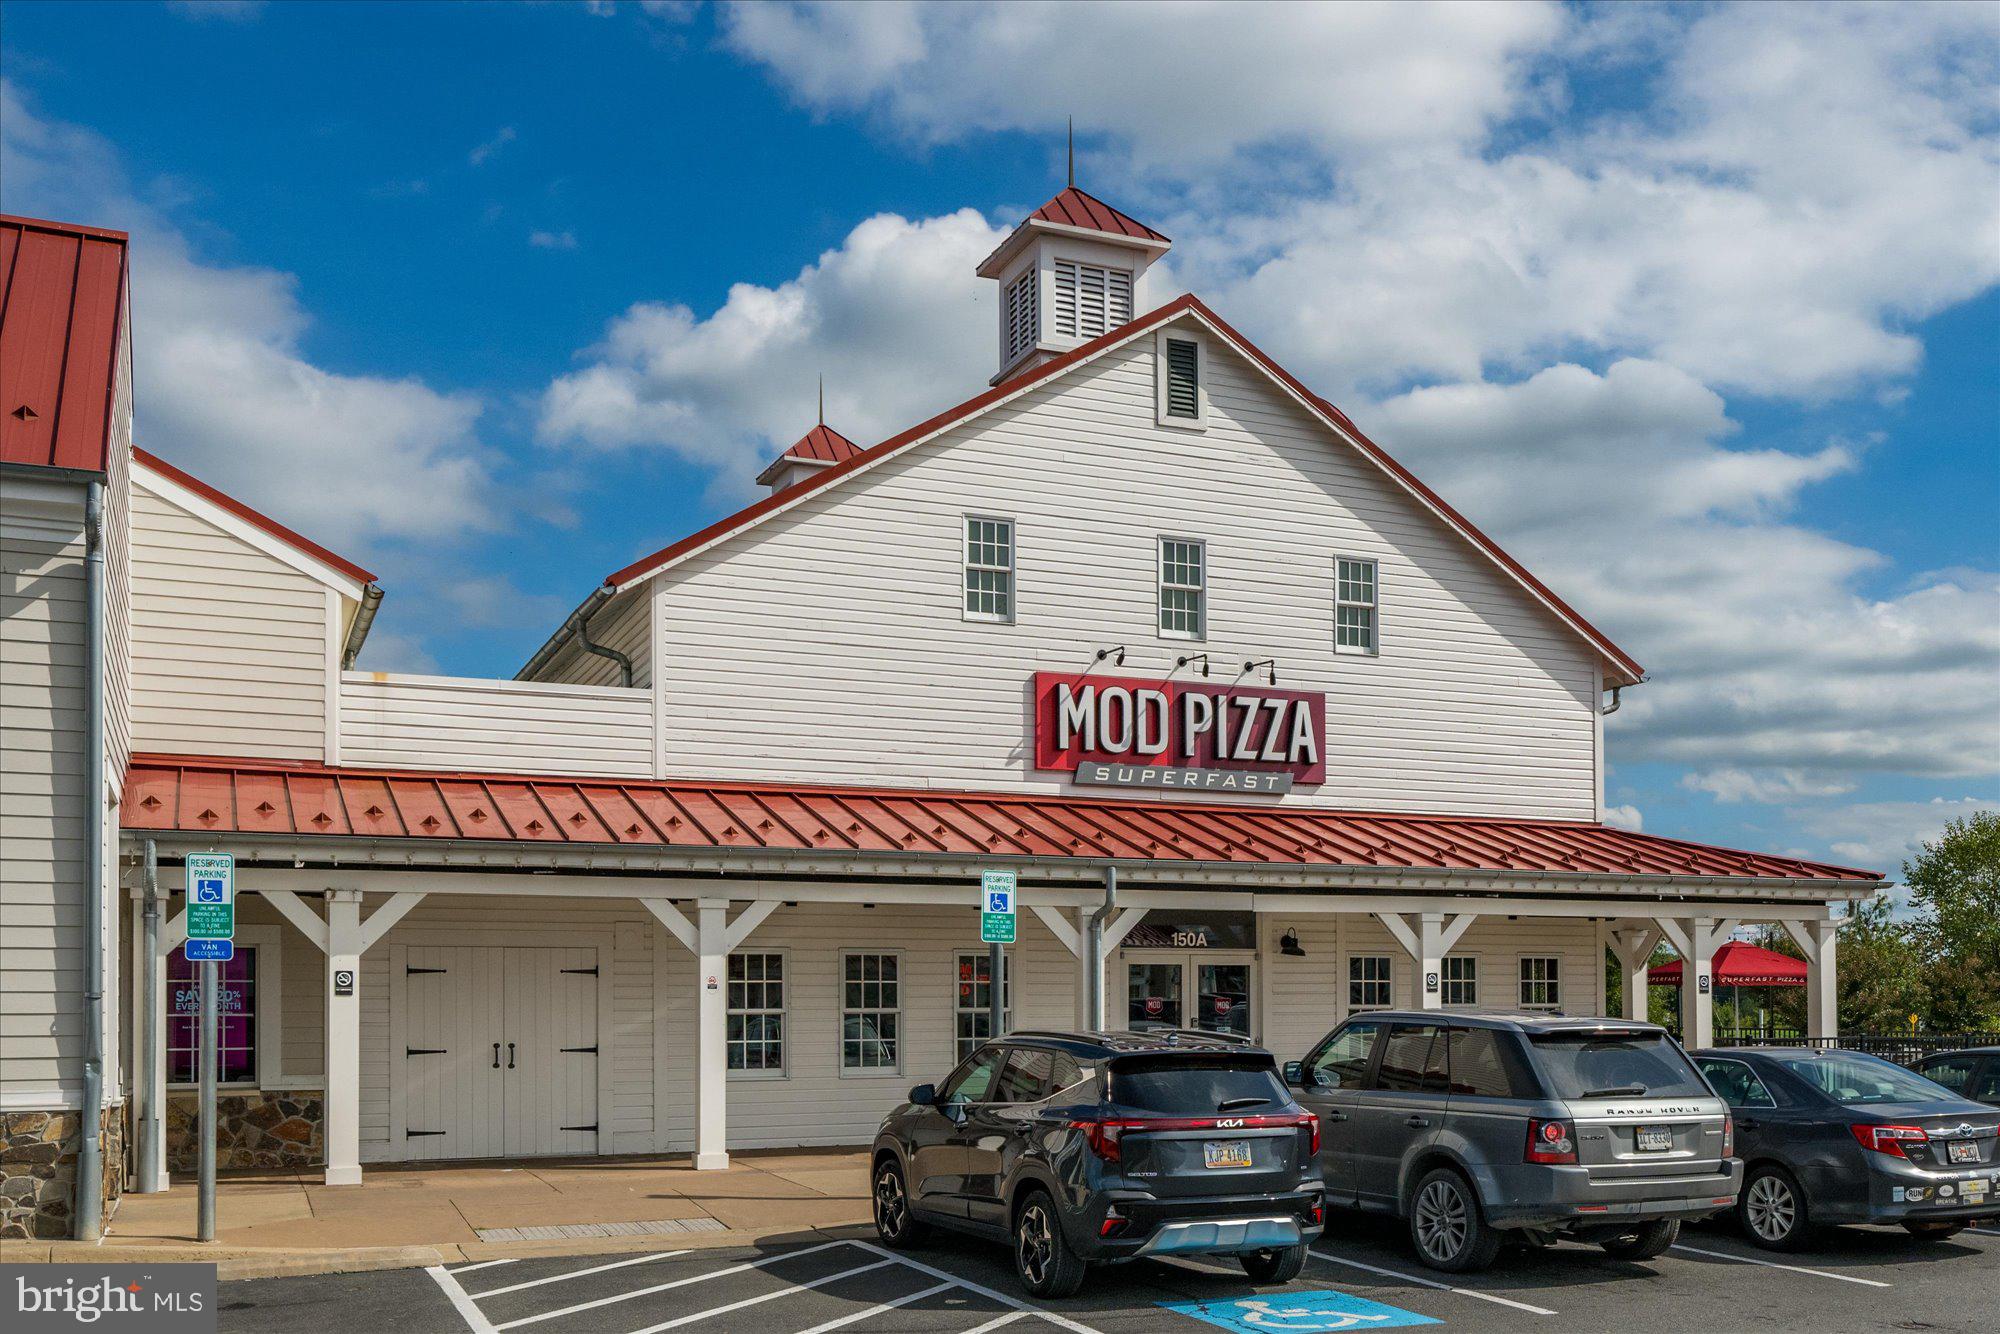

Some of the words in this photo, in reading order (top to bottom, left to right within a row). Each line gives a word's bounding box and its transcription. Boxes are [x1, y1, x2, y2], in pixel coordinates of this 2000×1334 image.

[1058, 683, 1169, 753] MOD
[1184, 691, 1318, 764] PIZZA
[1095, 767, 1279, 790] SUPERFAST
[190, 859, 230, 867] RESERVED
[194, 870, 227, 879] PARKING
[987, 884, 1011, 893] PARKING
[1171, 932, 1208, 947] 150A
[1147, 1001, 1161, 1009] MOD
[1217, 1119, 1243, 1127] KIA
[1908, 1189, 1922, 1197] RUN
